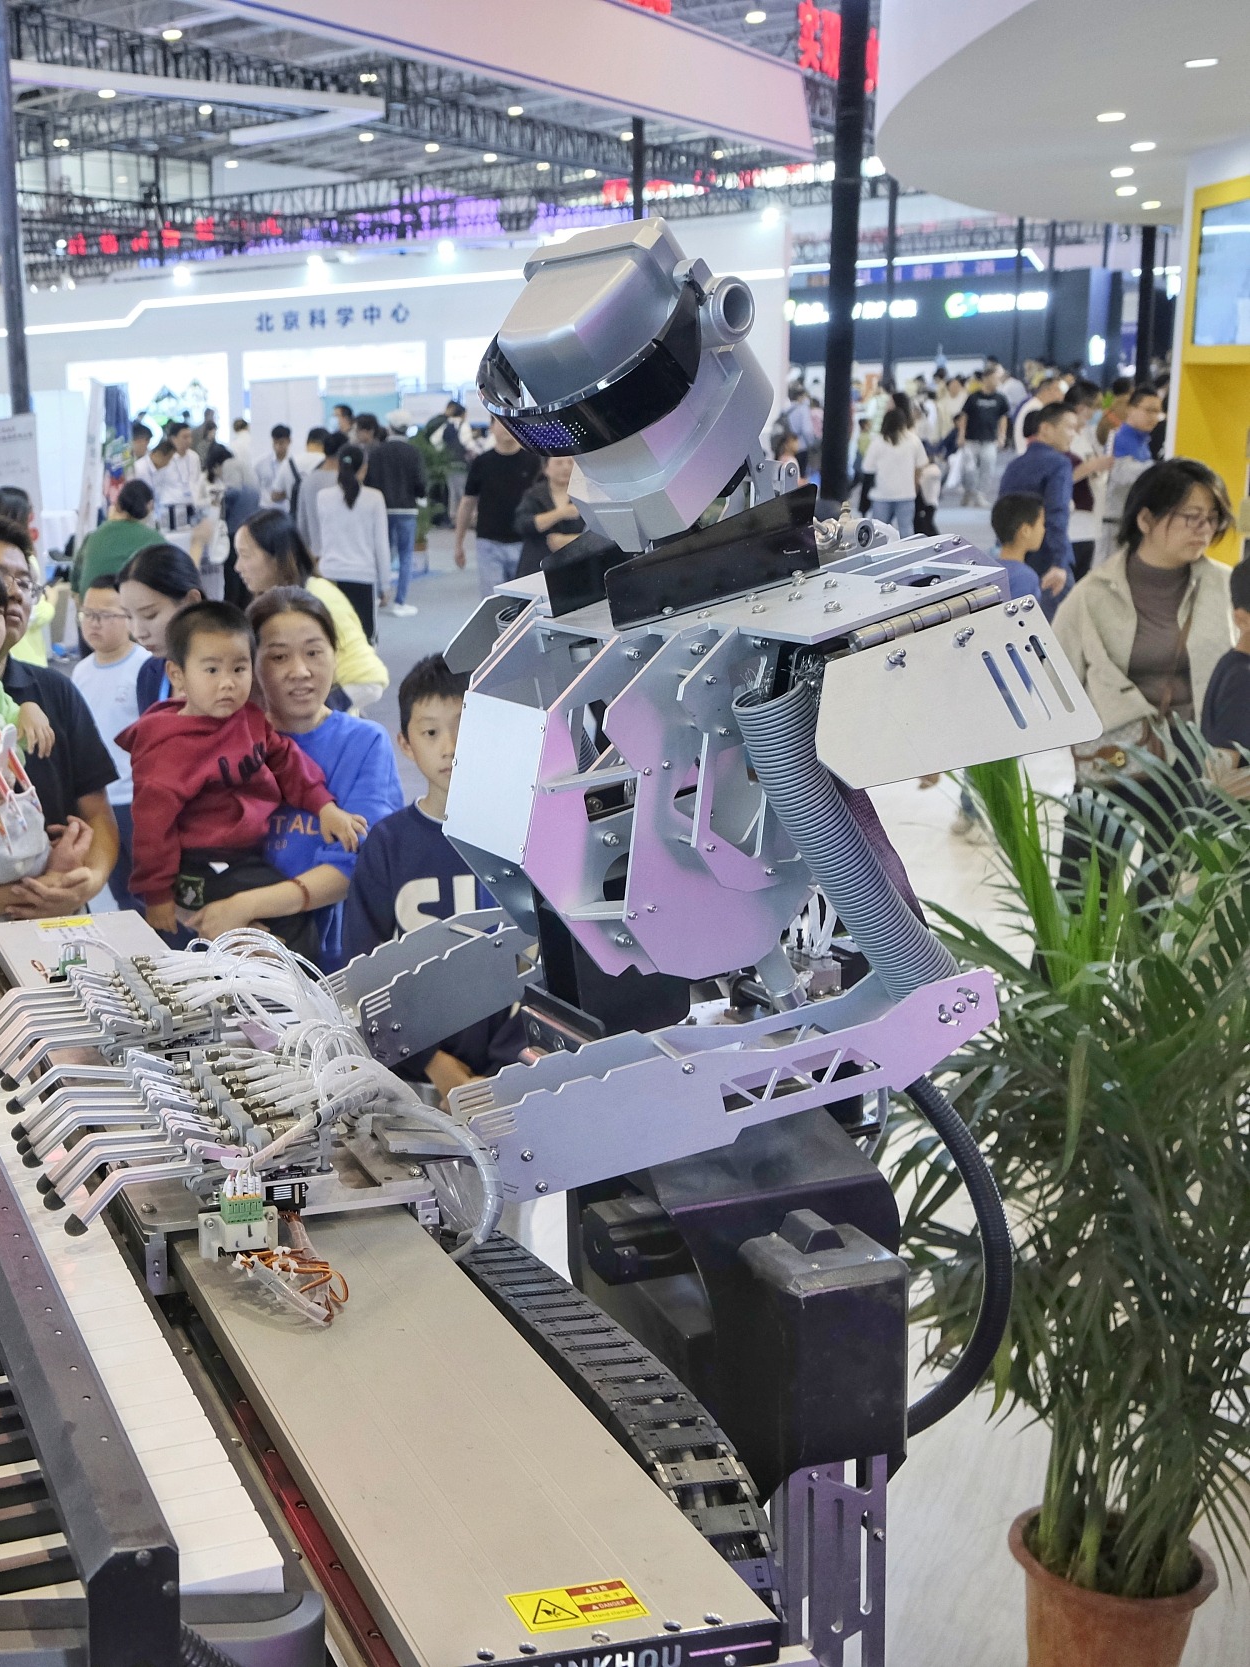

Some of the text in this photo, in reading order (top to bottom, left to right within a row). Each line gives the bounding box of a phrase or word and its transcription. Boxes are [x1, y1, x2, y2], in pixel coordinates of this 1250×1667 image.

[255, 302, 410, 332] 北京科学中心
[598, 1600, 627, 1609] DANGER
